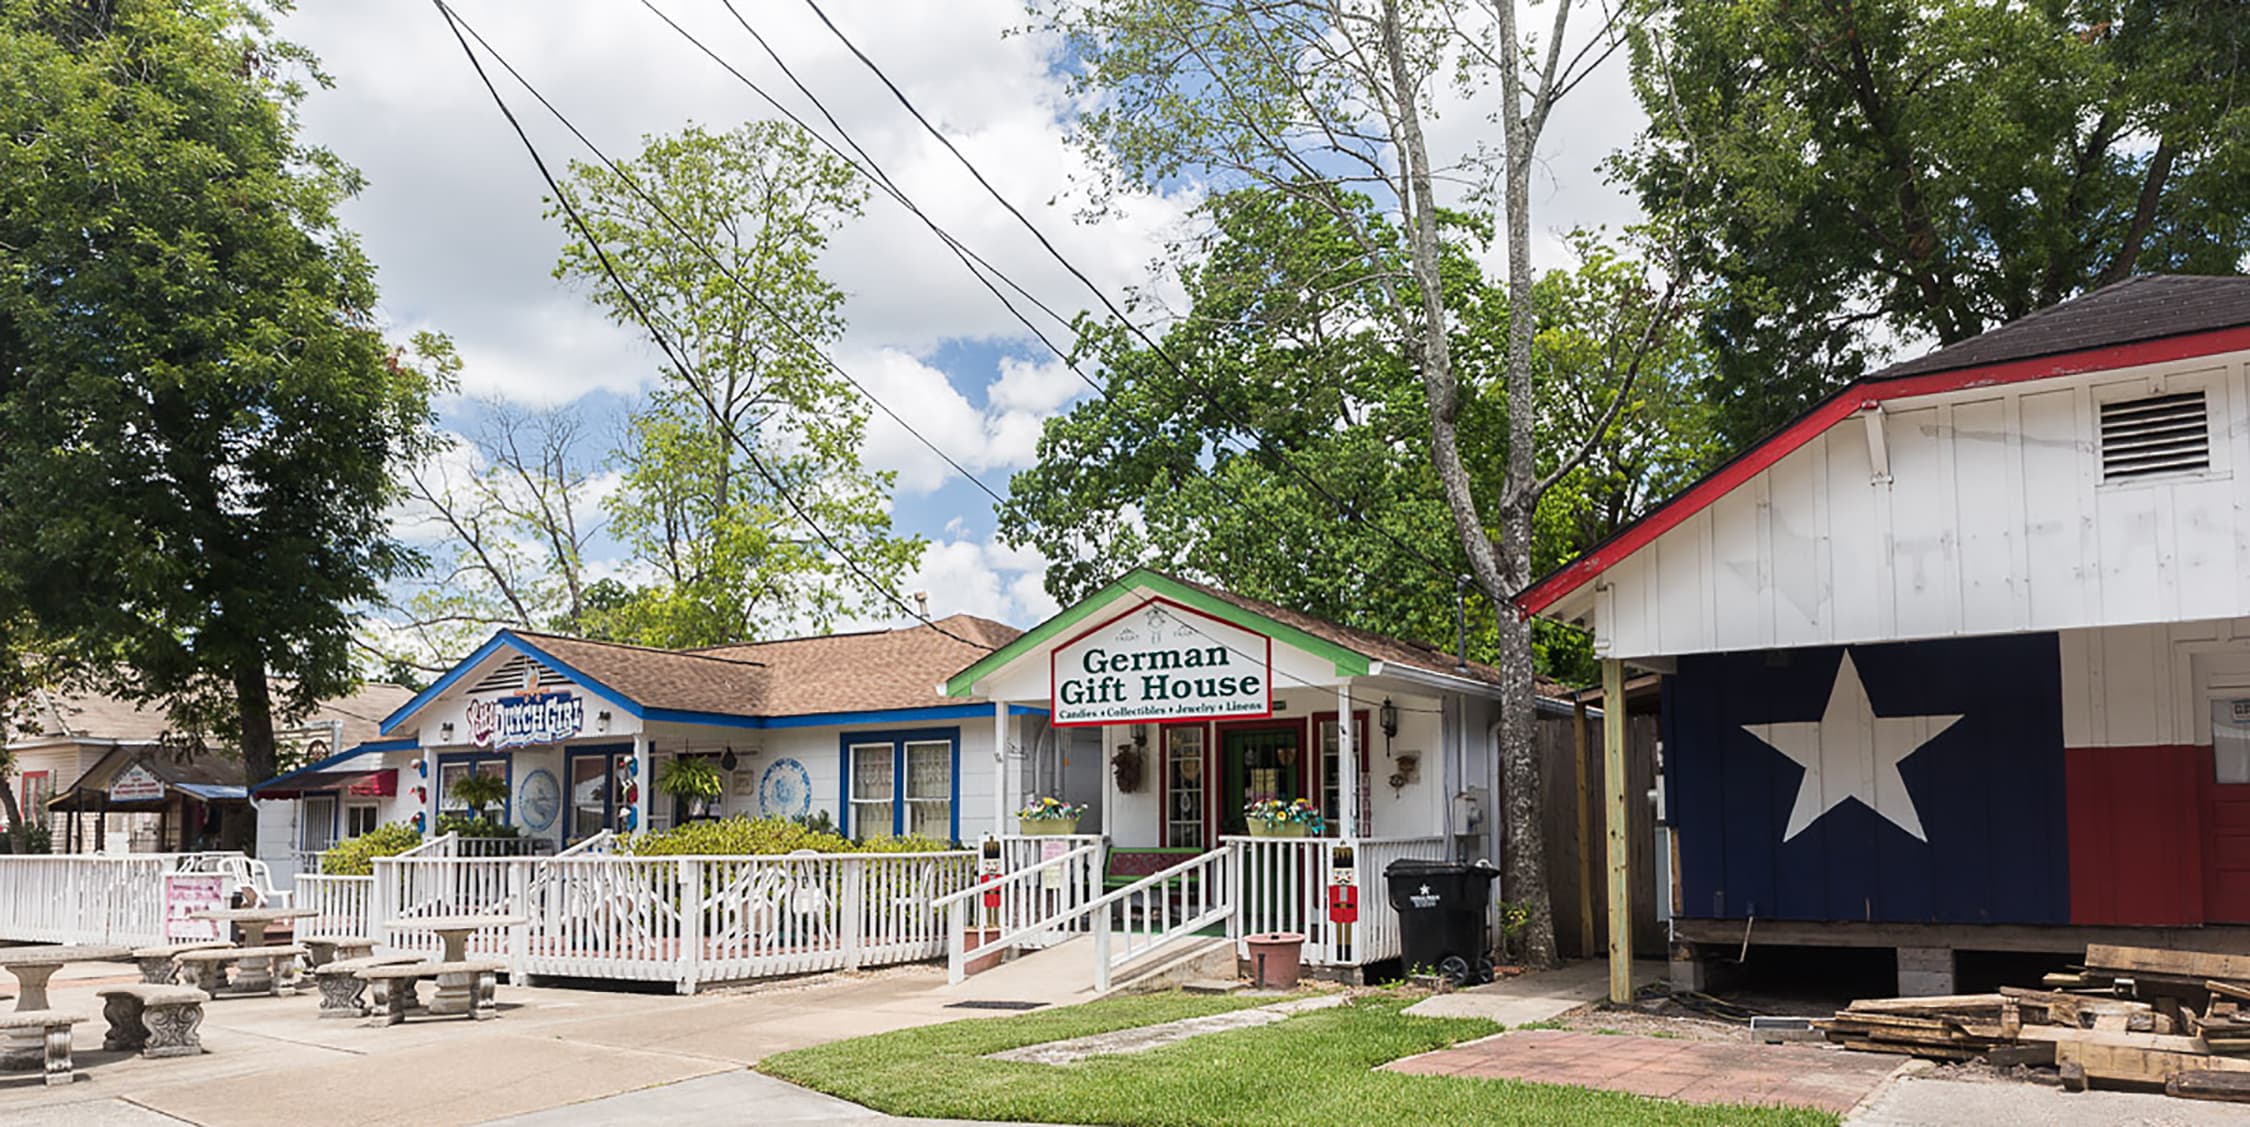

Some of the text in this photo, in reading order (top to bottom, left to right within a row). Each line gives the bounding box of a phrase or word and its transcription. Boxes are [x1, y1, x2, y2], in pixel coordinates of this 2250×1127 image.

[1083, 646, 1230, 674] German
[1060, 674, 1260, 705] Gift House
[1059, 708, 1098, 720] Candies
[1106, 705, 1166, 718] Collectibles
[1175, 702, 1216, 715] Jewelry
[1225, 700, 1263, 713] Linens
